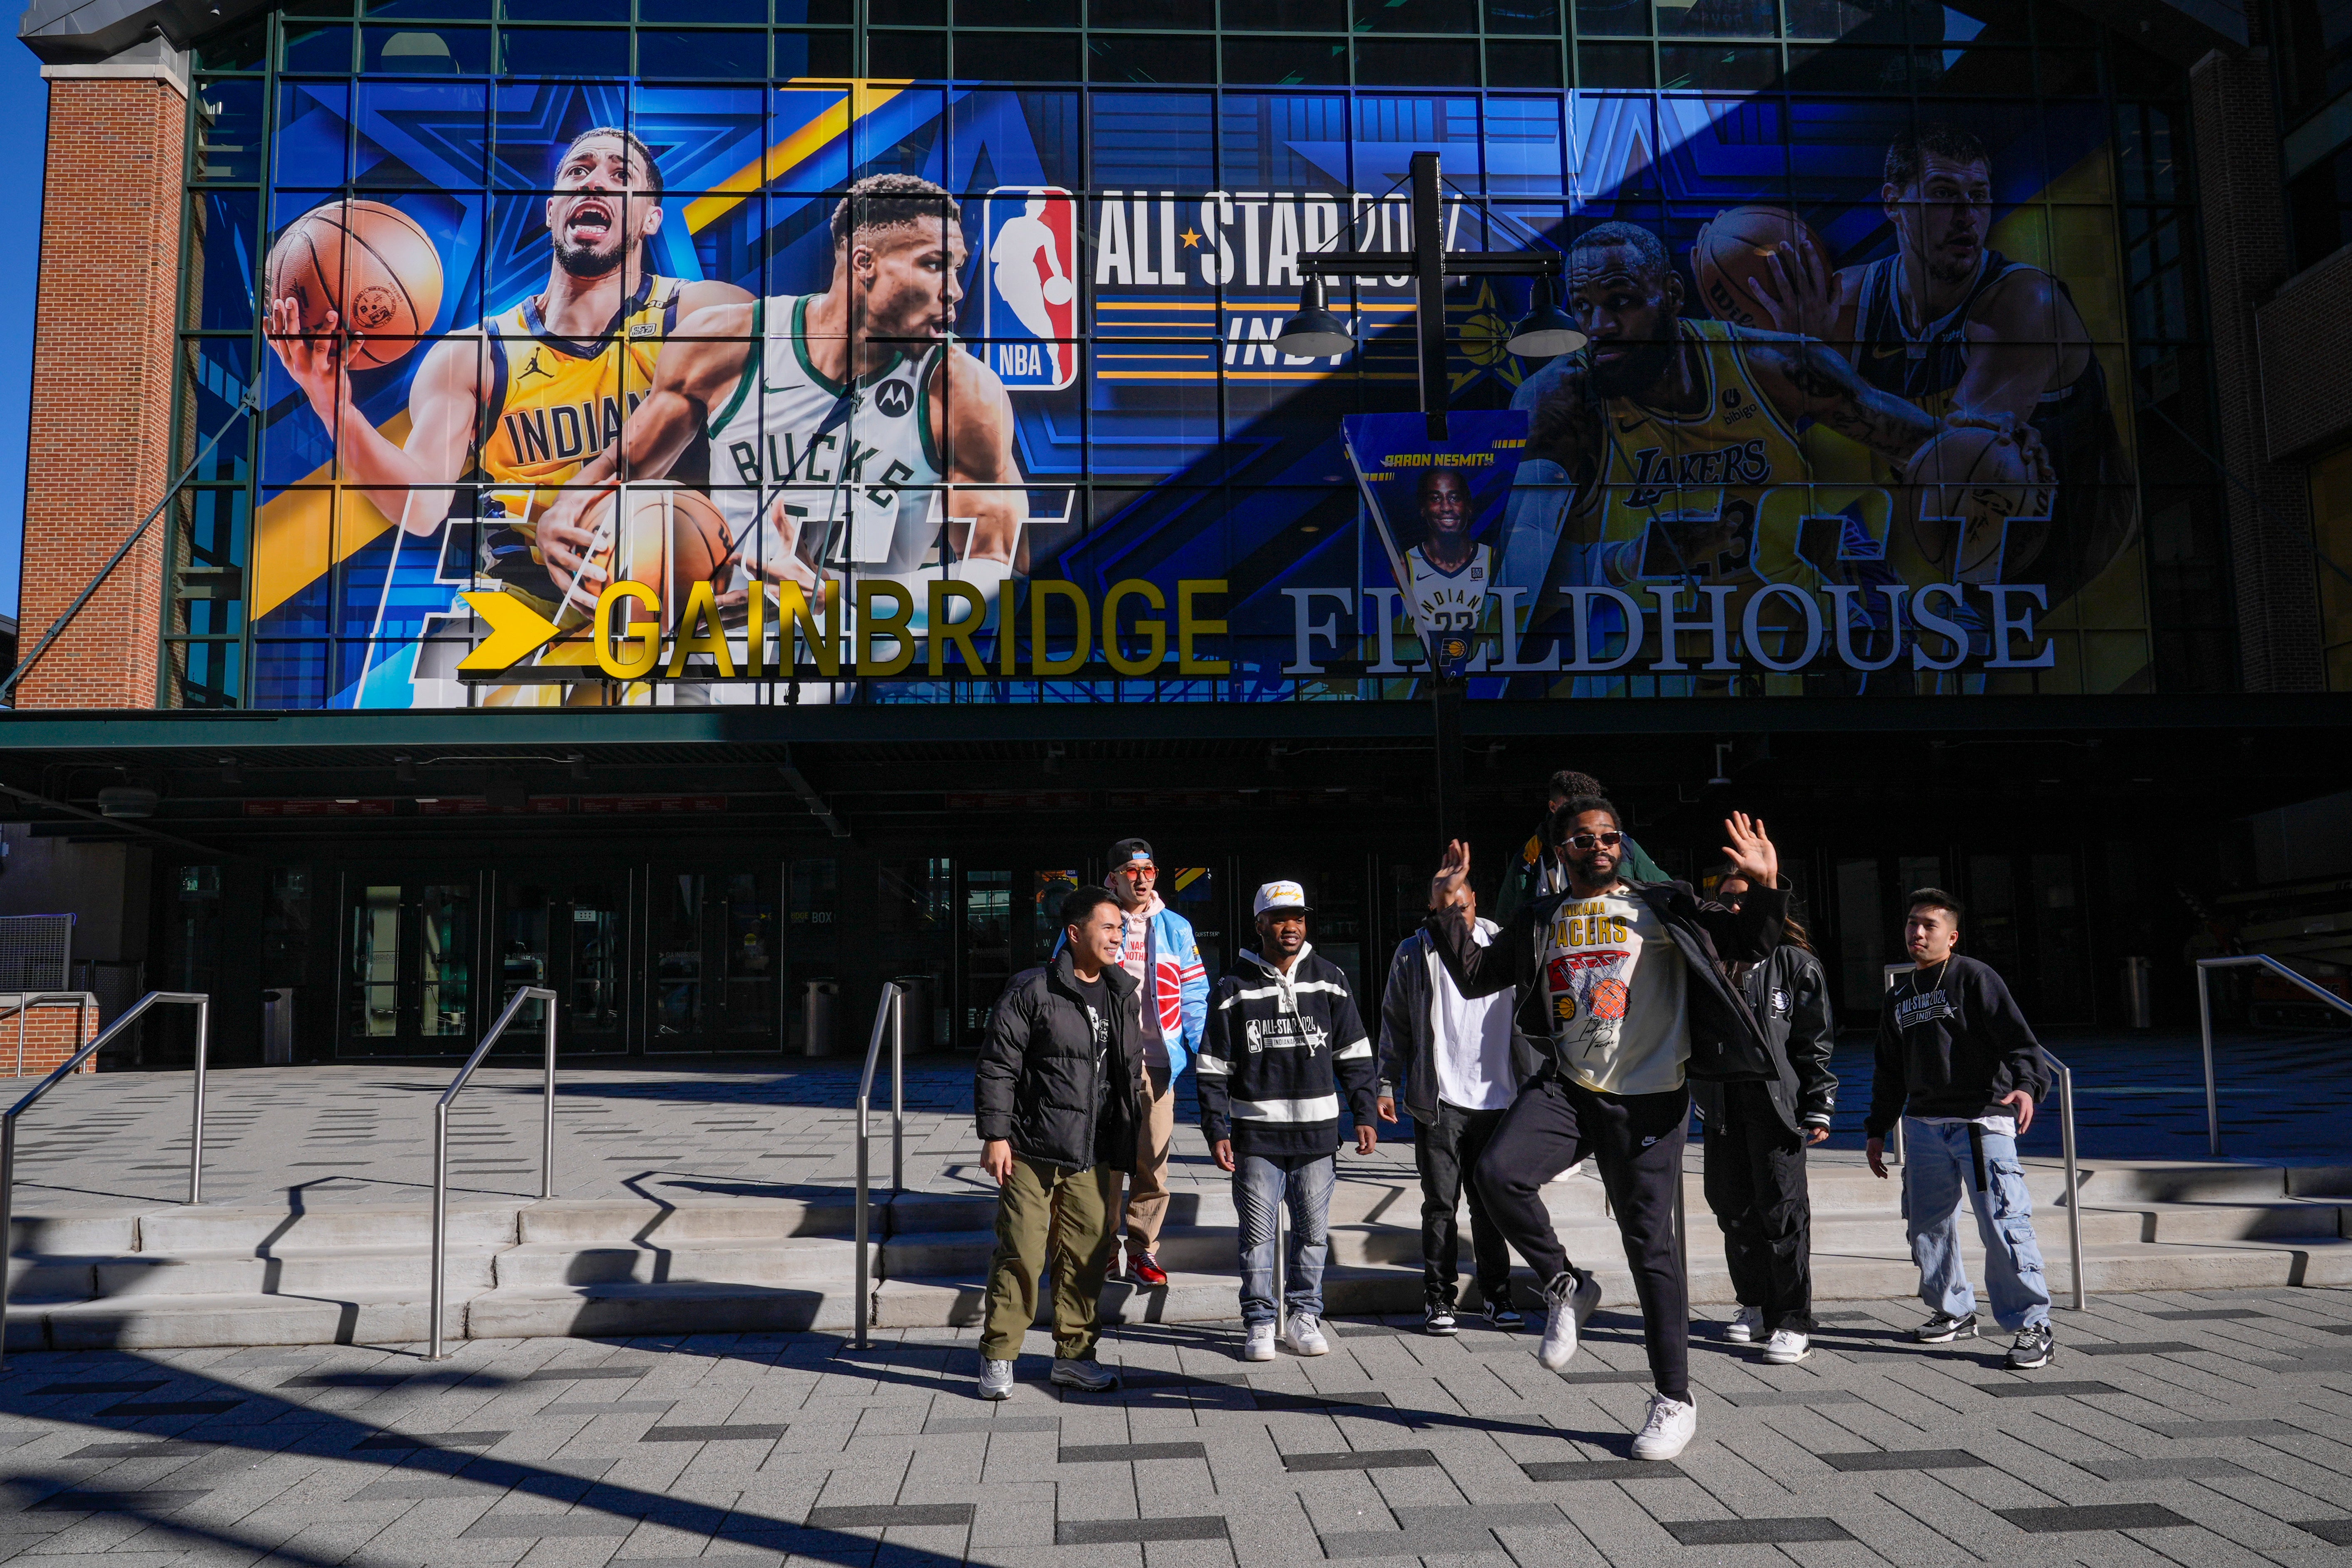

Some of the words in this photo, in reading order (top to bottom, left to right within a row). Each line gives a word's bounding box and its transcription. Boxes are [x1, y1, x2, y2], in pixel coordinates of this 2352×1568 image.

[1355, 192, 1468, 287] 204
[999, 345, 1042, 376] NBA
[504, 389, 653, 465] INDIA
[1384, 453, 1431, 467] AARON
[1434, 453, 1494, 467] NESMITH
[729, 431, 915, 509] BUCKS
[1623, 438, 1772, 508] LAKERS
[593, 579, 1231, 682] GAINBRIDGE
[1281, 582, 2055, 674] FILDHOUSE
[812, 911, 832, 923] BOX
[1561, 901, 1605, 918] INDIANA
[1915, 1010, 1932, 1021] INDY
